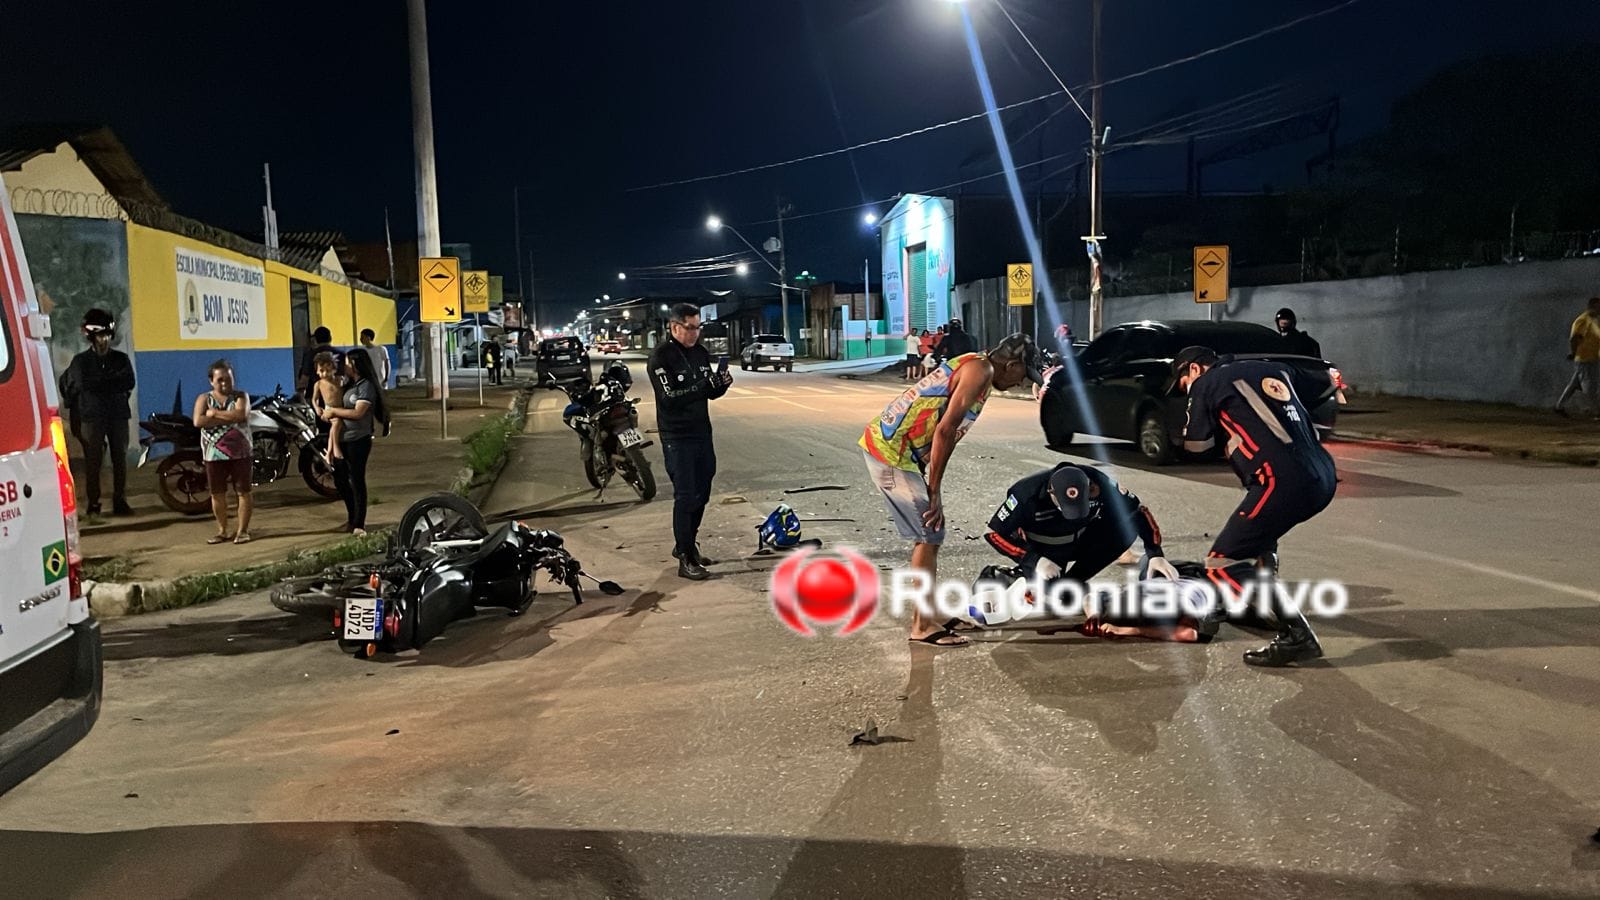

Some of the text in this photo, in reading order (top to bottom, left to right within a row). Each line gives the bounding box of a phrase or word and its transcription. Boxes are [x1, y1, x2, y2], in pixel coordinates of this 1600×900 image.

[203, 294, 249, 324] BOM JESUS
[0, 507, 22, 523] ERVA
[348, 605, 361, 635] 4D72
[362, 608, 374, 631] NDP
